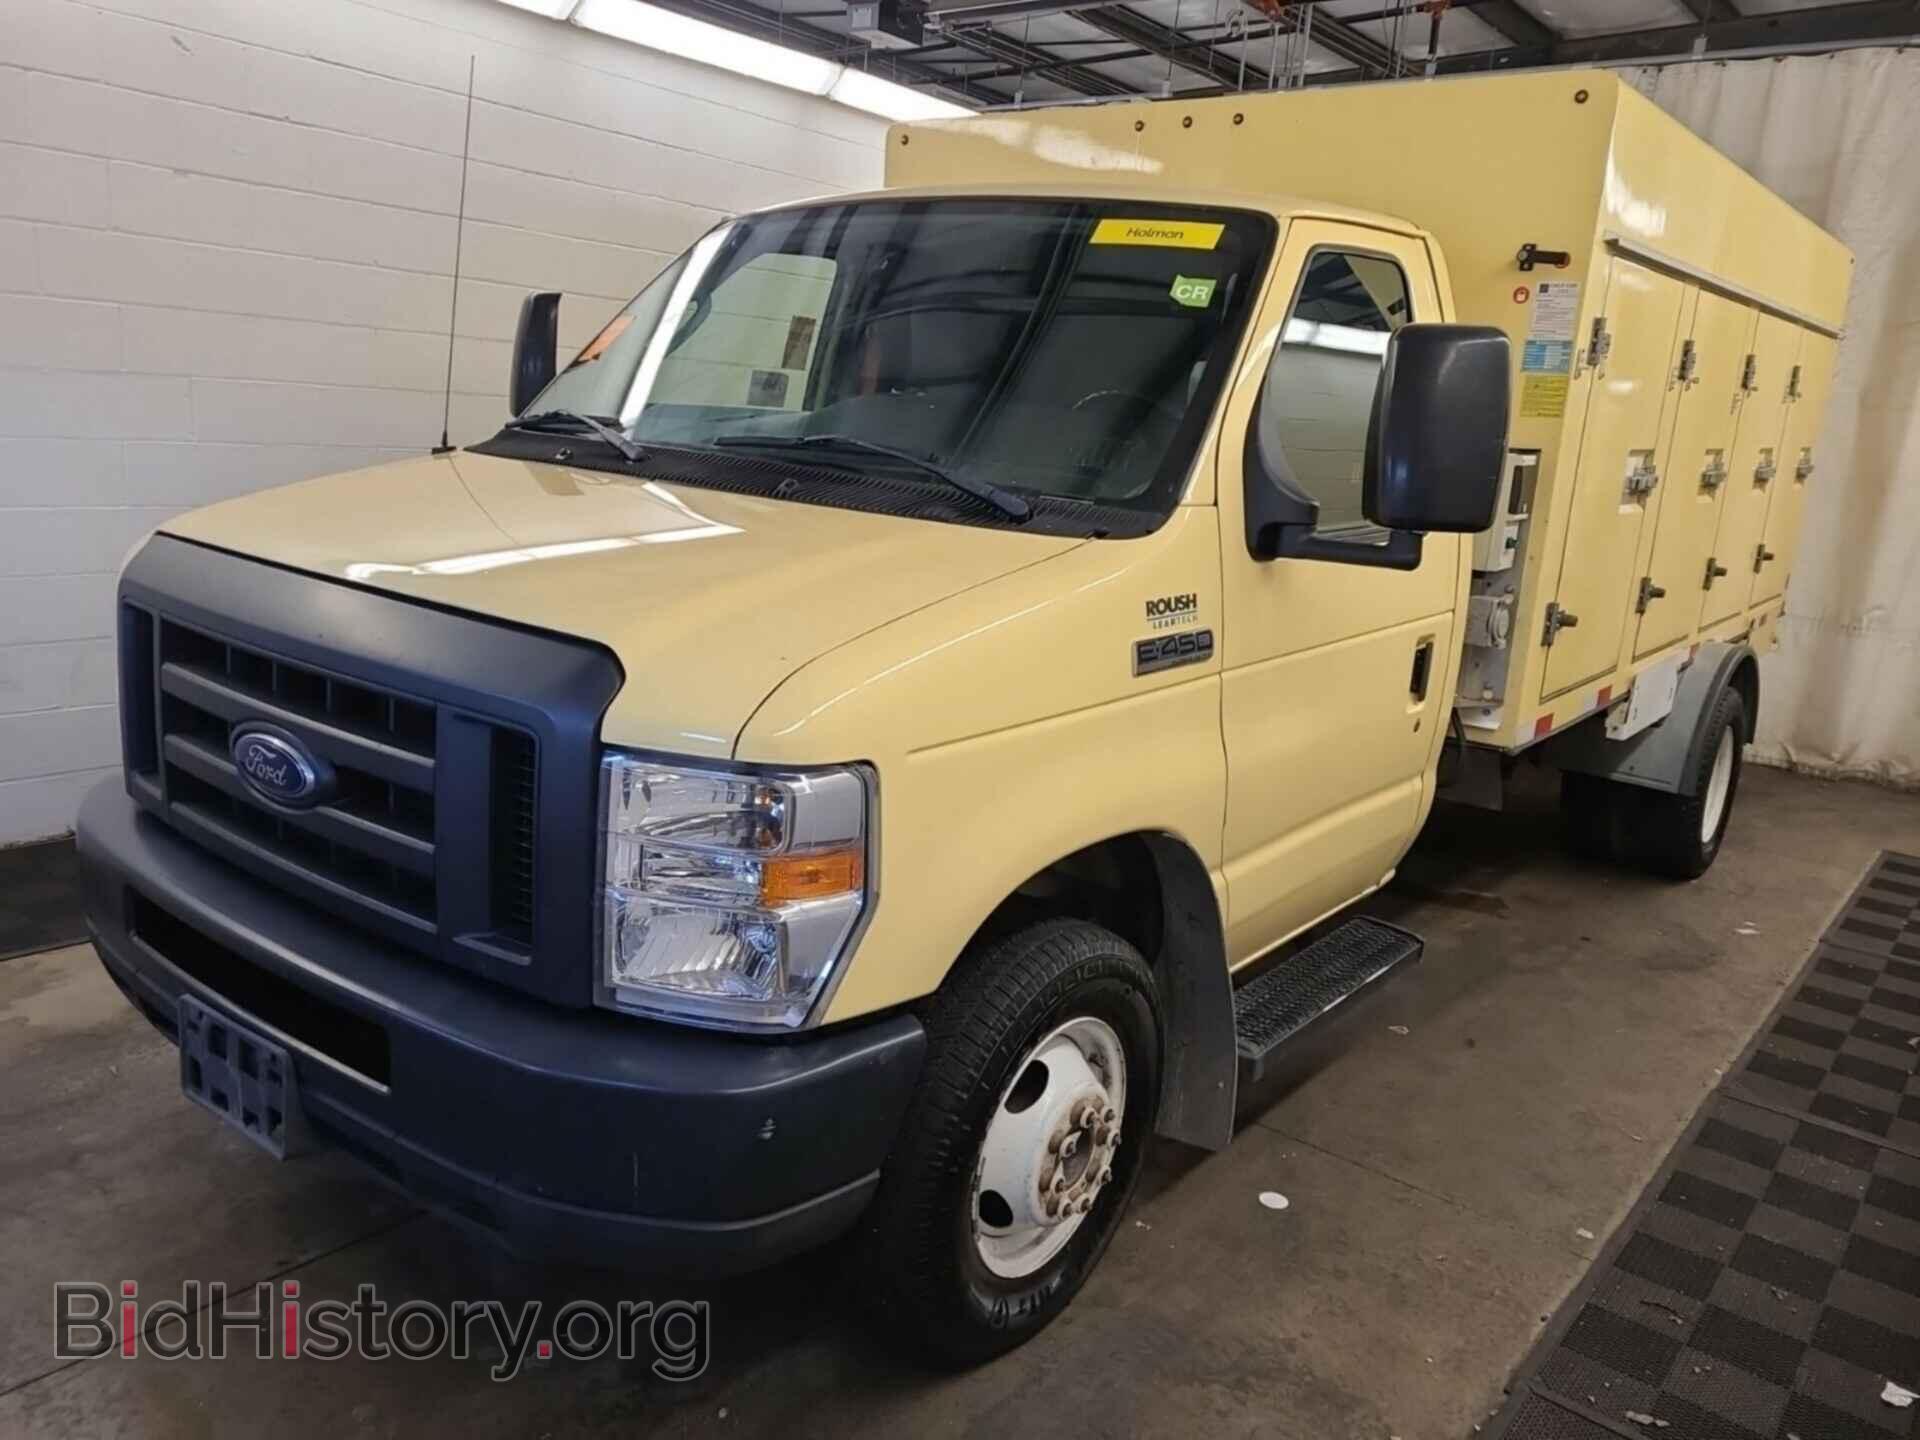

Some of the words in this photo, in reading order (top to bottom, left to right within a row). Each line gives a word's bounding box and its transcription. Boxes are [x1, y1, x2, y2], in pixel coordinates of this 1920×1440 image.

[1126, 227, 1185, 240] Holman
[1176, 285, 1209, 300] CR
[1145, 593, 1197, 617] ROUSH
[247, 744, 288, 786] Ford
